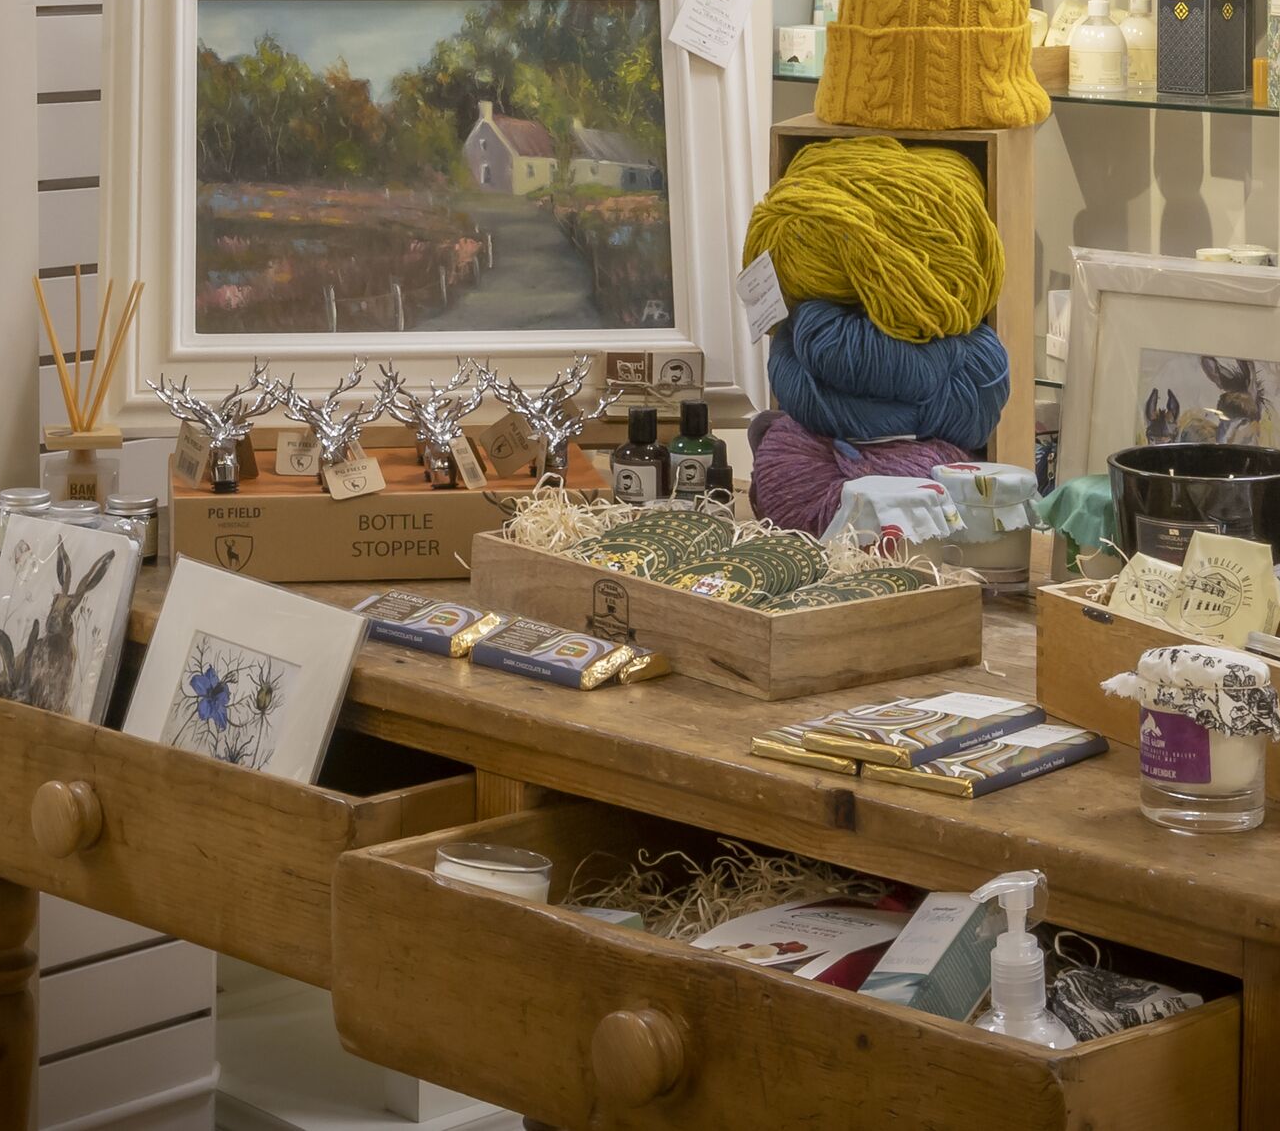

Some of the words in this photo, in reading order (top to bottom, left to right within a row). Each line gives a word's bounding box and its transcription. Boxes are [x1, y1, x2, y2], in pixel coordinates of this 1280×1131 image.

[70, 483, 96, 496] BAM
[207, 508, 224, 520] PG
[227, 507, 261, 519] FIELD
[358, 512, 433, 532] BOTTLE
[351, 539, 440, 558] STOPPER
